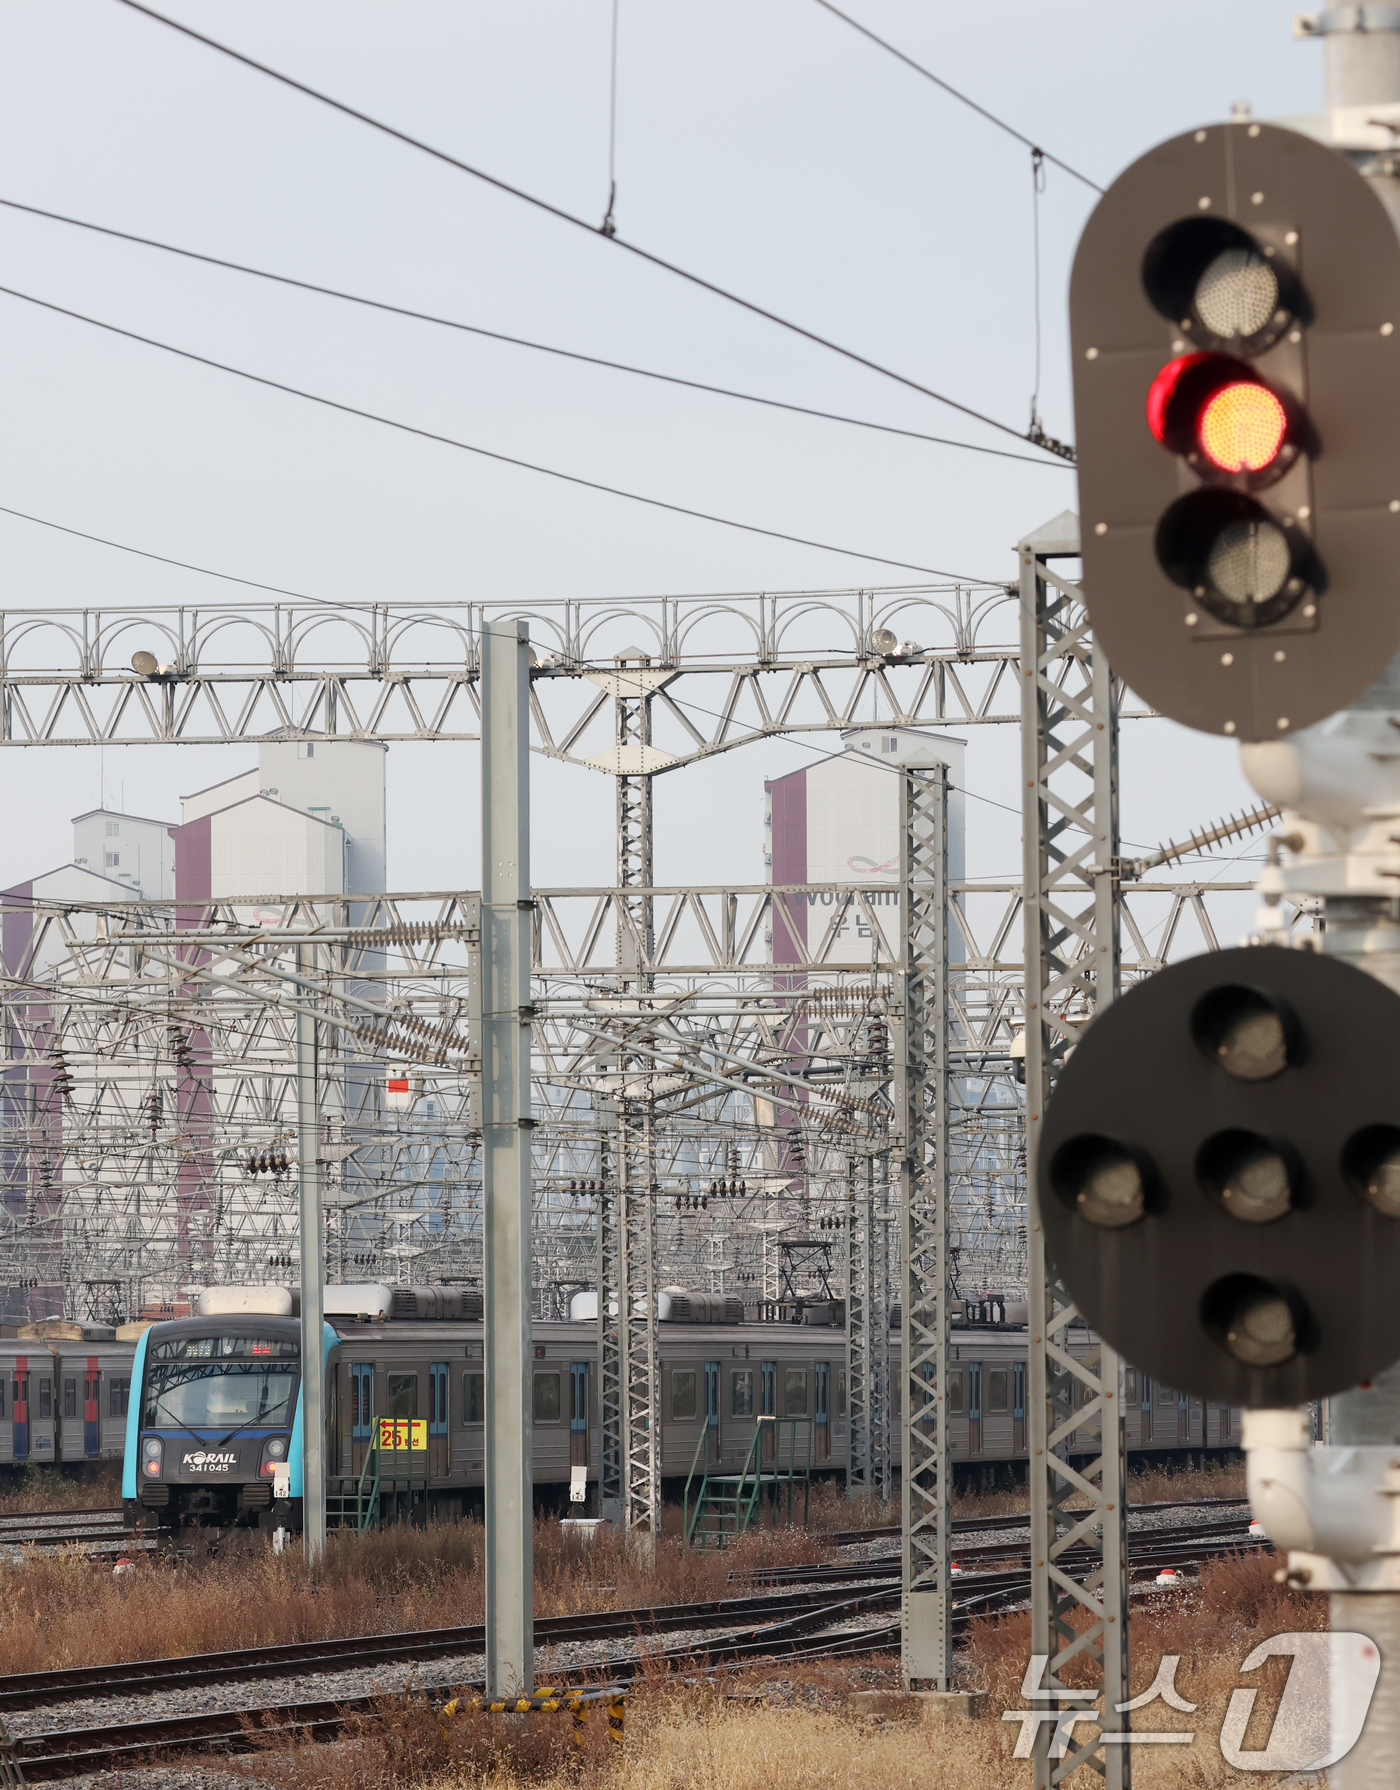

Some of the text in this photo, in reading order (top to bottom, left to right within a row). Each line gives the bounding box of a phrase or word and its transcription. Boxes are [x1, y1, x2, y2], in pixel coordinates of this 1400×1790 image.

[381, 1430, 402, 1447] 25
[182, 1451, 237, 1465] KORAIL
[189, 1464, 229, 1472] 341045
